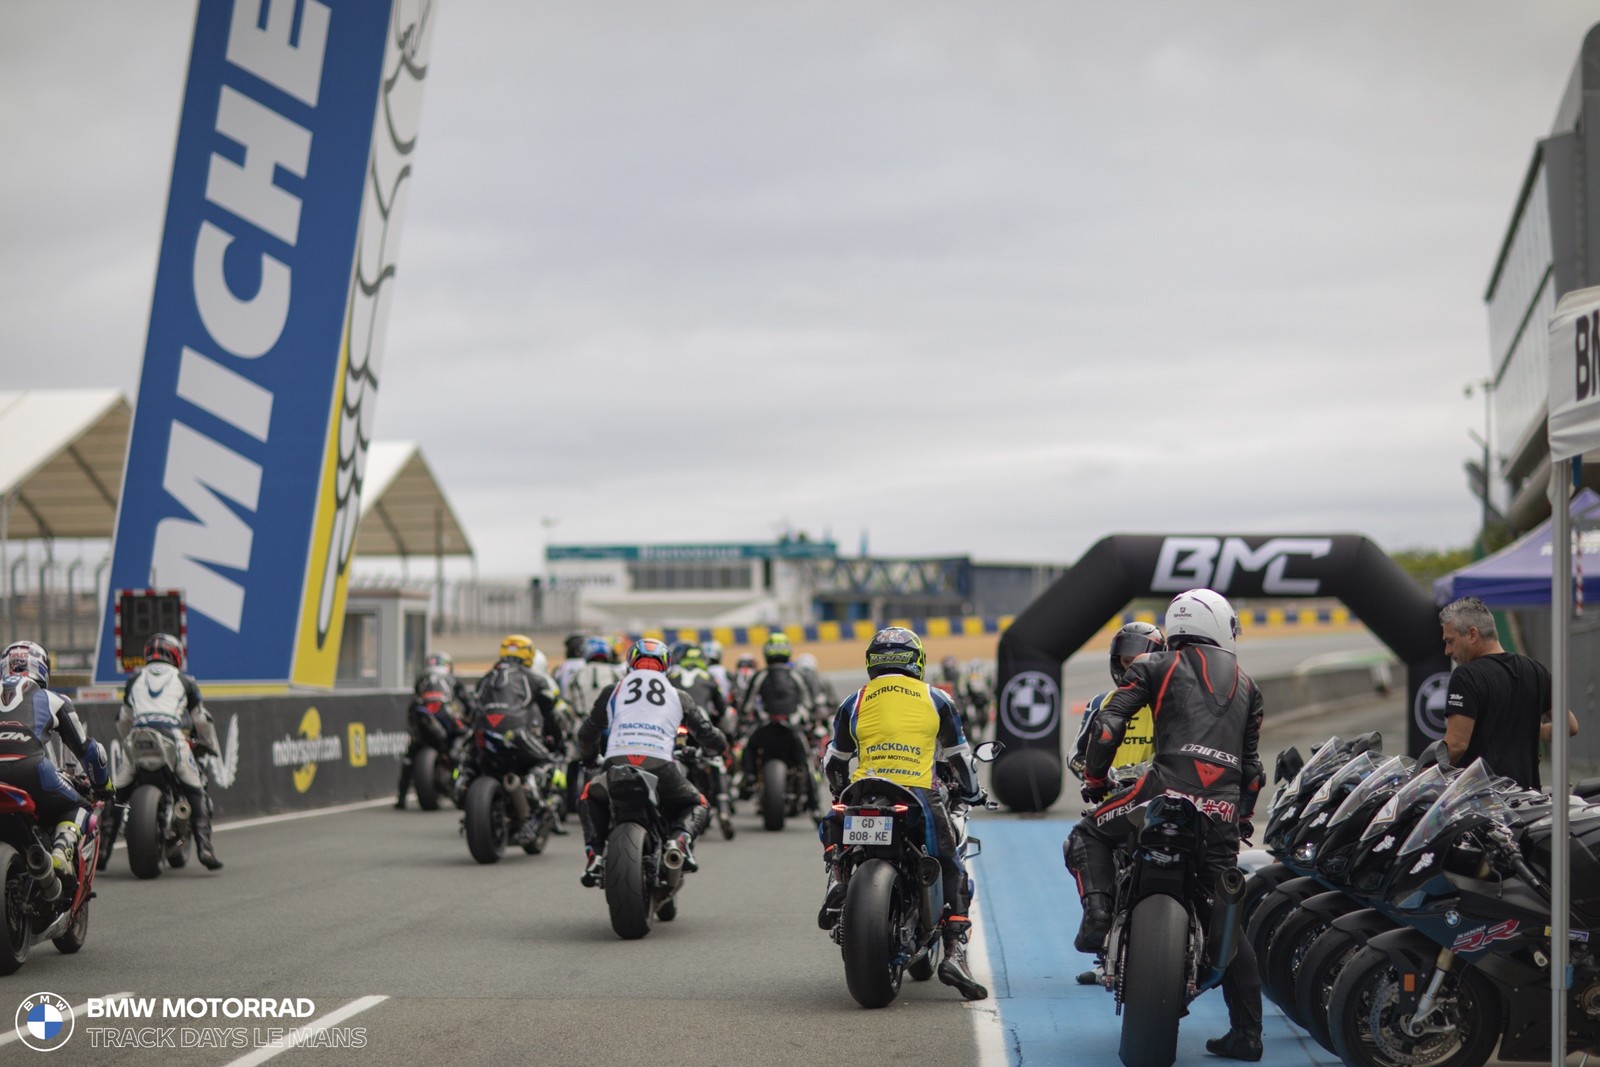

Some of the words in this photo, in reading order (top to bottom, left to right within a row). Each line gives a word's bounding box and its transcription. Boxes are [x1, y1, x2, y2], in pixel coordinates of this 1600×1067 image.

[148, 0, 332, 634] MICHE
[1150, 536, 1332, 595] BMC
[624, 677, 666, 707] 38
[865, 685, 921, 702] INSTRUCTEUR
[866, 742, 921, 756] TRACKDAYS
[1180, 743, 1239, 766] DAINESE
[878, 768, 921, 777] MICHELIN
[861, 818, 875, 829] GD
[1096, 799, 1137, 827] DAINESE
[1450, 919, 1523, 955] RR
